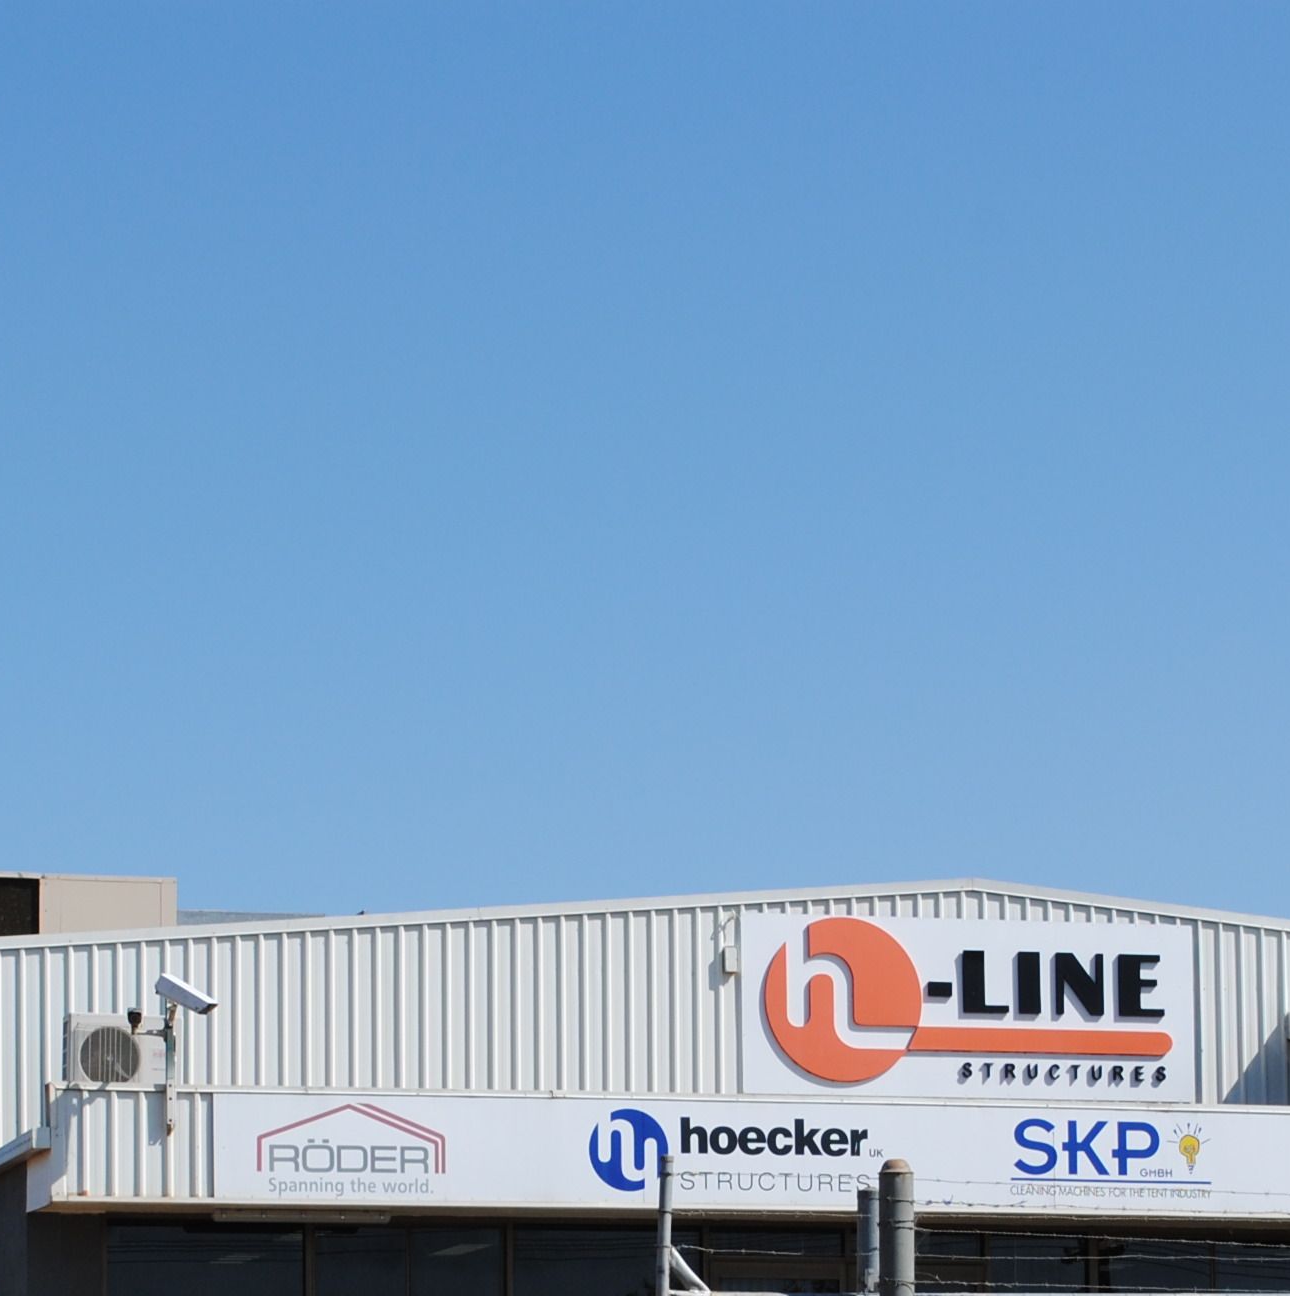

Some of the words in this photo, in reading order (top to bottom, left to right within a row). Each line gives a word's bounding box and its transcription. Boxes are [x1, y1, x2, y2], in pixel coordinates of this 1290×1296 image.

[959, 1061, 1168, 1084] STRUCTURES
[679, 1116, 869, 1157] hoecker
[868, 1147, 885, 1159] UK
[1013, 1117, 1160, 1176] SKP
[1139, 1167, 1174, 1178] GMBH
[268, 1138, 430, 1174] RÖDER
[268, 1177, 345, 1197] Spanning
[350, 1178, 377, 1193] the
[377, 1178, 435, 1195] world.
[679, 1171, 871, 1193] STRUCTURES
[1009, 1184, 1056, 1197] CLEANING
[1058, 1185, 1107, 1198] MACHINES
[1109, 1186, 1127, 1198] FOR
[1128, 1187, 1145, 1199] THE
[1146, 1187, 1169, 1199] TENT
[1169, 1187, 1213, 1200] INDUSTRY
